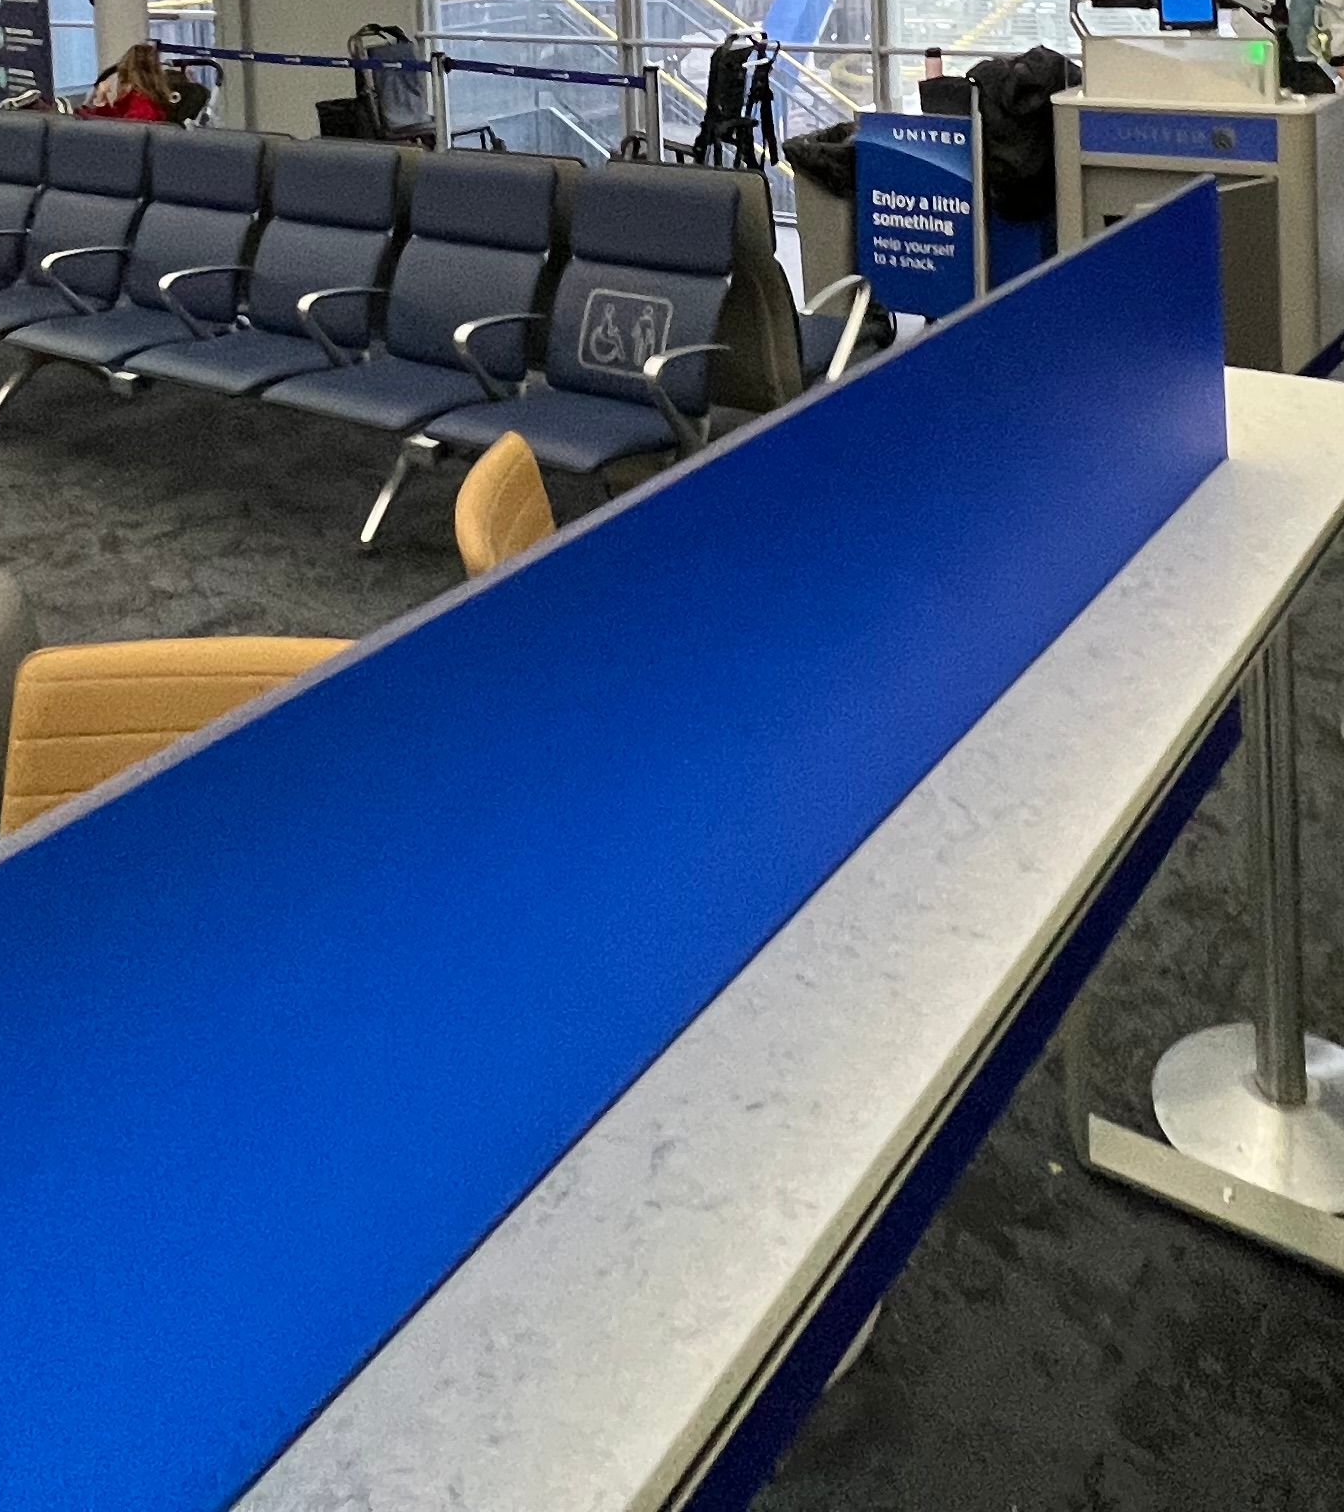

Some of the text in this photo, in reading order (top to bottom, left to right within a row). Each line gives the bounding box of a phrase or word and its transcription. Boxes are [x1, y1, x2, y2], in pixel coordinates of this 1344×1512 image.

[892, 127, 967, 146] UNITED
[872, 189, 970, 215] Enjoy a little
[872, 212, 954, 236] something
[873, 236, 955, 257] Help yourself
[873, 252, 887, 265] to
[889, 255, 897, 267] a
